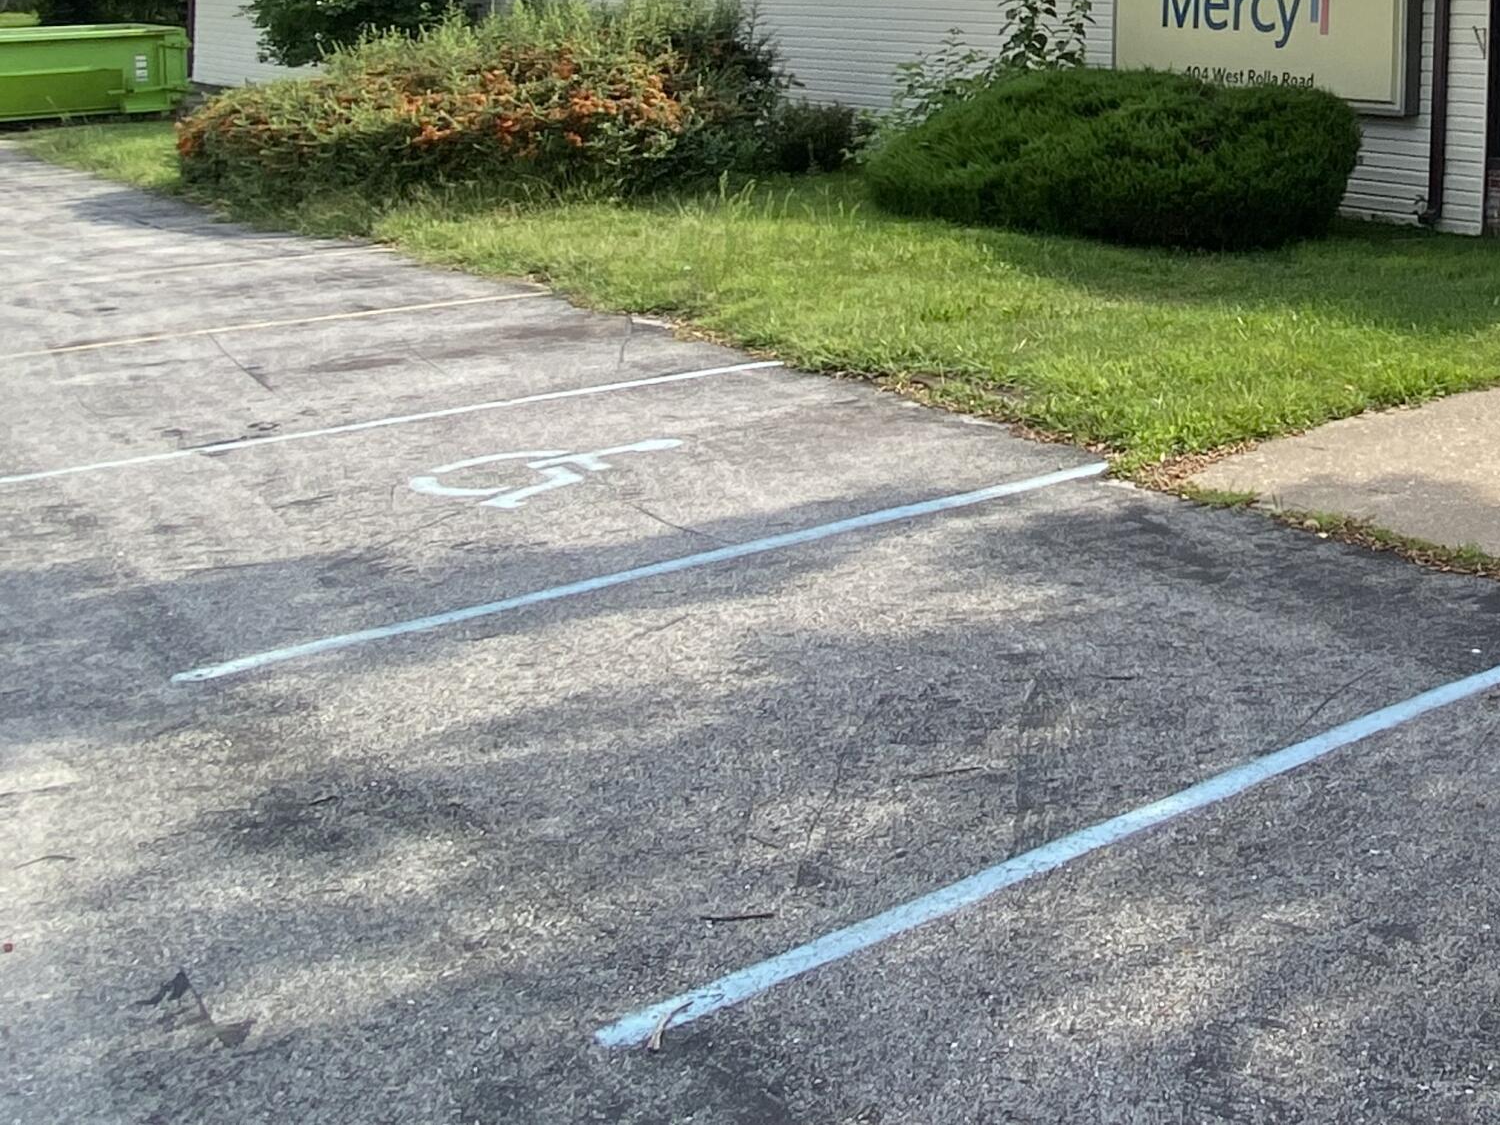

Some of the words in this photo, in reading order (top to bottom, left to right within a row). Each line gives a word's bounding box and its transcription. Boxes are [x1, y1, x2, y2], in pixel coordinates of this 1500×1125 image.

[1212, 67, 1244, 84] West
[1247, 69, 1278, 86] Rolla
[1281, 72, 1314, 89] Road
